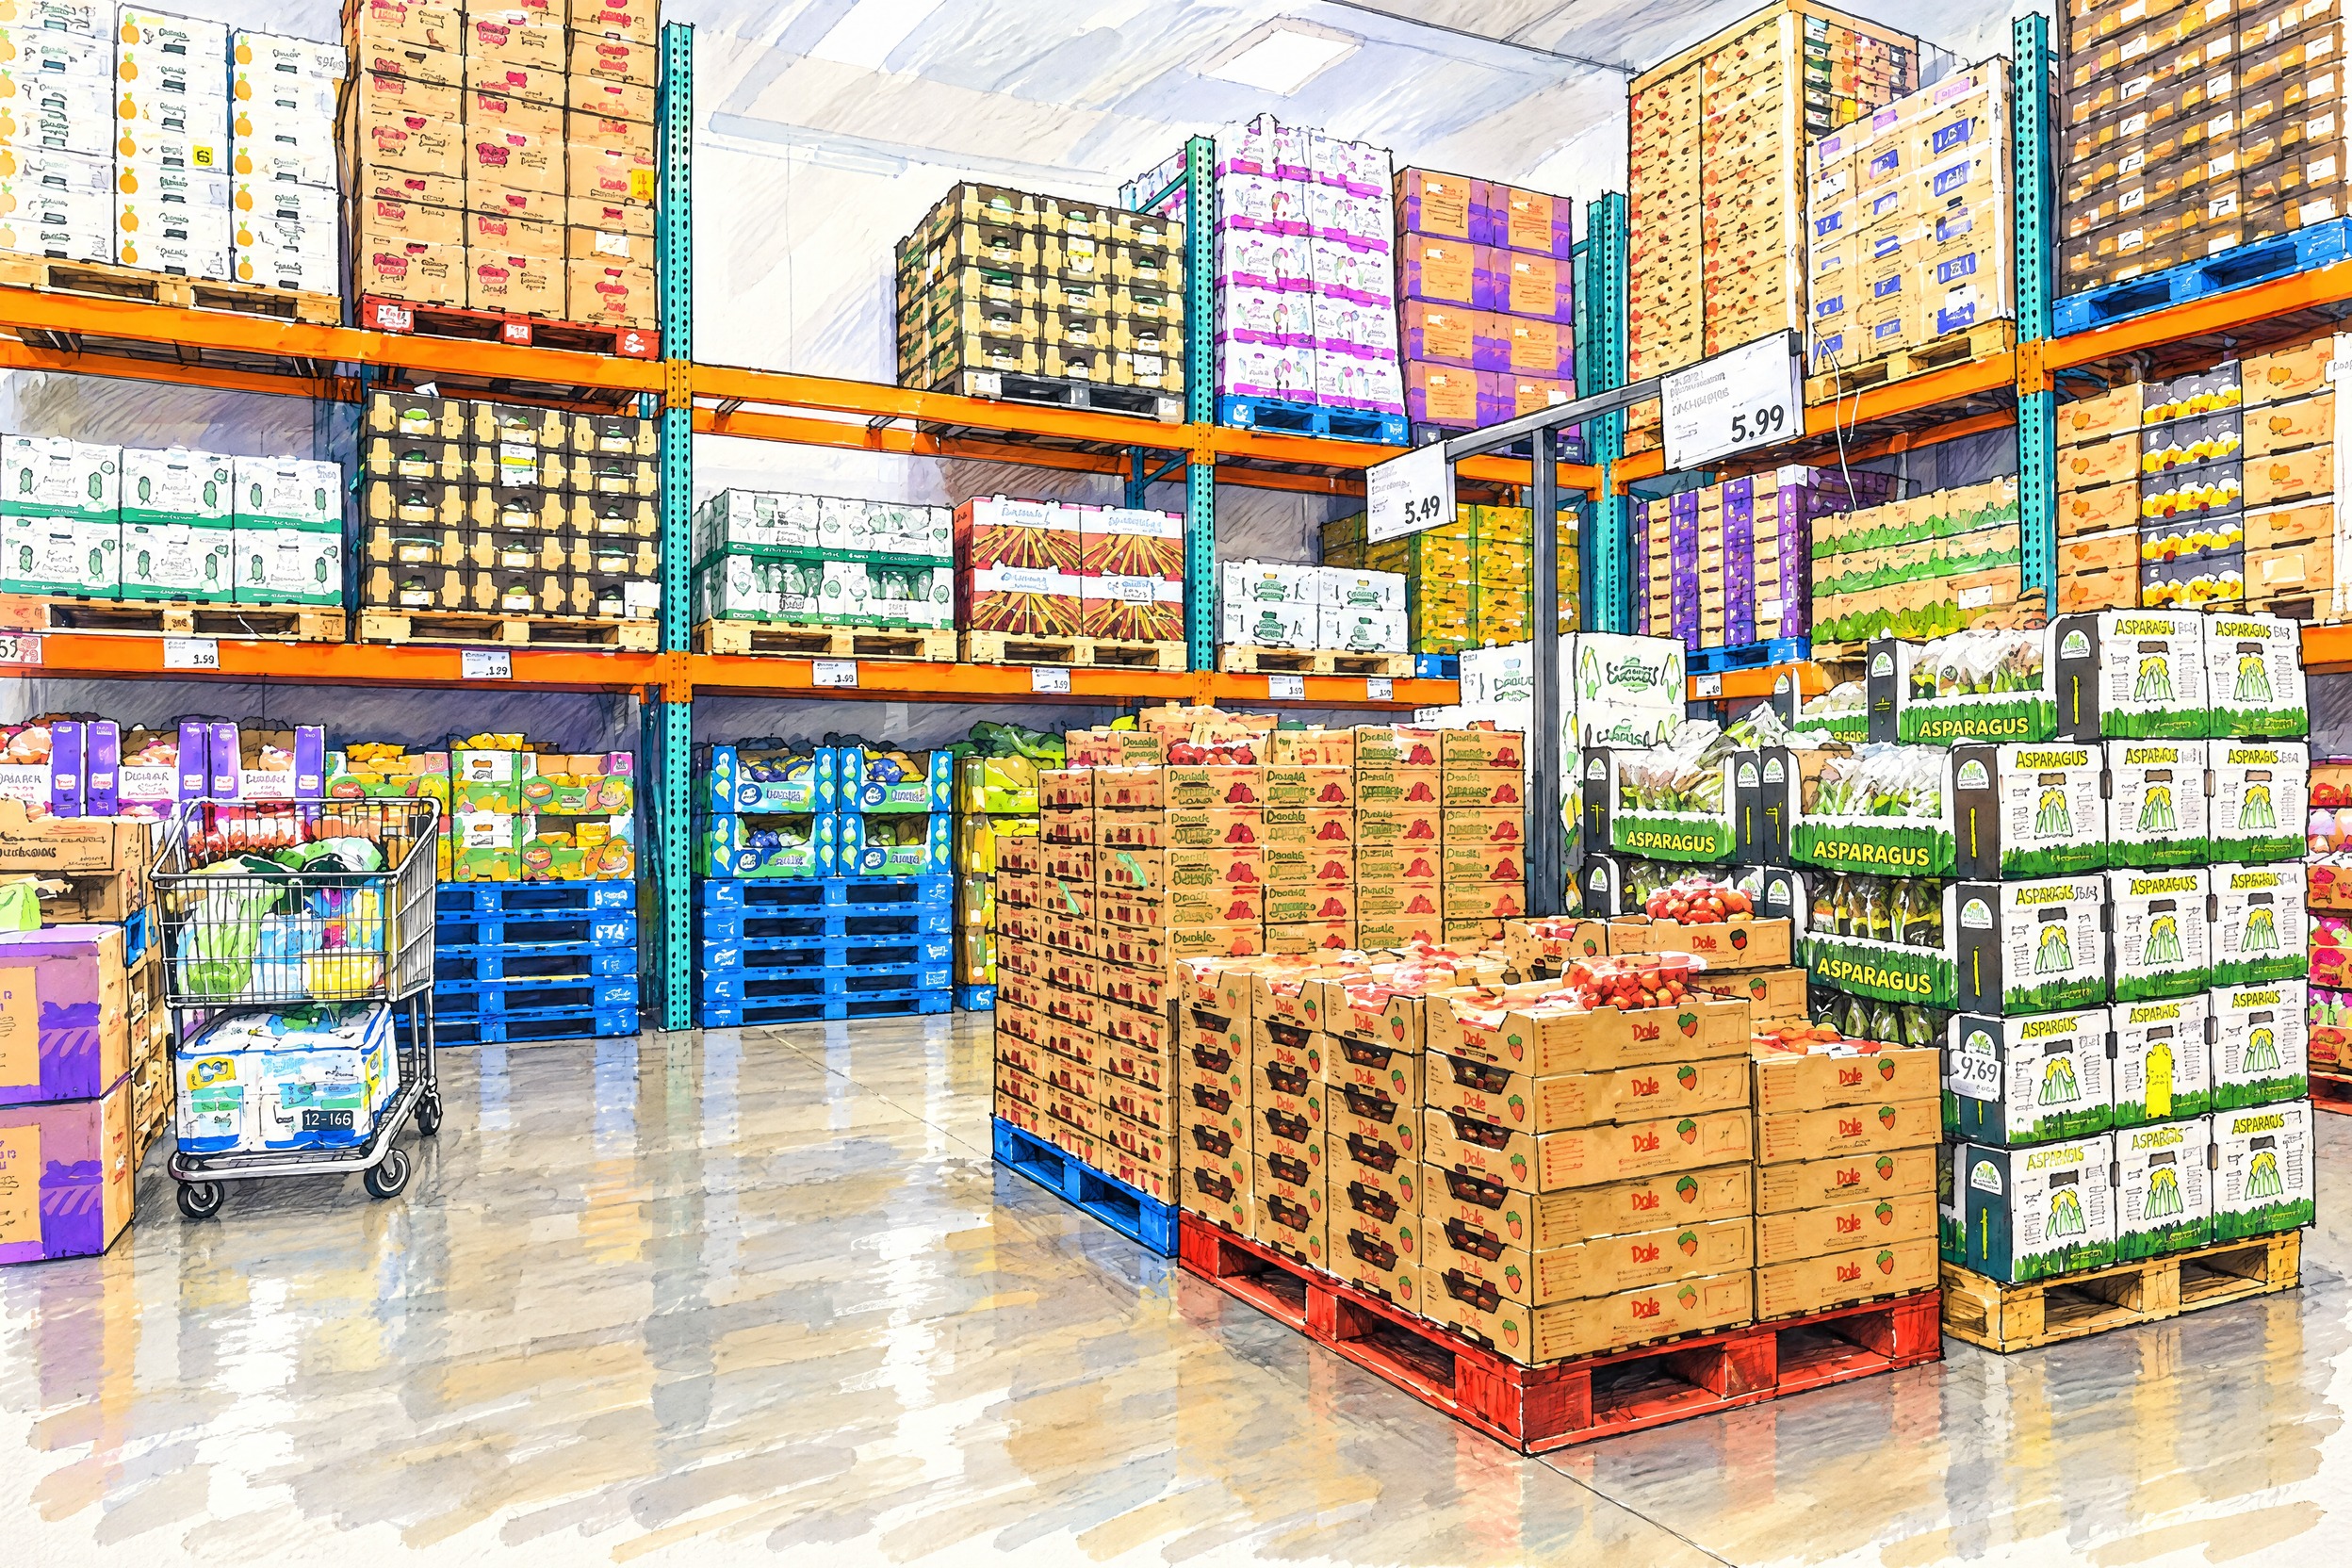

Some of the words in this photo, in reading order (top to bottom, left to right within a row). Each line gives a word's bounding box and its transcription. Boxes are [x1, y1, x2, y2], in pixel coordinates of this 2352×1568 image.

[1731, 404, 1785, 443] 5.99
[1405, 495, 1441, 525] 5.49
[1919, 717, 2029, 739] ASPARAGUS
[2016, 751, 2089, 769] ASPARAGUS
[1625, 830, 1716, 854] ASPARAGUS
[1813, 841, 1931, 867] ASPARAGUS
[2130, 876, 2197, 895] ASPARAGUS
[1543, 939, 1561, 956] Dole
[1691, 935, 1717, 950] Dole
[1816, 956, 1933, 994] ASPARAGUS
[1198, 988, 1216, 1001] Dole
[1275, 999, 1295, 1014] Dole
[1353, 1013, 1374, 1031] Dole
[1631, 1021, 1660, 1040] Dole
[1200, 1032, 1217, 1046] Dole
[1463, 1030, 1486, 1046] Dole
[1276, 1048, 1296, 1066] Dole
[1200, 1071, 1218, 1086] Dole
[1354, 1068, 1376, 1086] Dole
[1838, 1067, 1863, 1085] Dole
[1961, 1055, 1998, 1083] 9.69
[1631, 1076, 1660, 1096] Dole
[1276, 1095, 1295, 1113] Dole
[1463, 1091, 1486, 1111] Dole
[304, 1113, 352, 1126] 12-166
[1201, 1112, 1218, 1127] Dole
[1358, 1119, 1379, 1138] Dole
[1838, 1118, 1863, 1135] Dole
[1277, 1139, 1295, 1156] Dole
[1631, 1131, 1660, 1152] Dole
[1202, 1155, 1219, 1171] Dole
[1463, 1149, 1486, 1168] Dole
[1359, 1168, 1380, 1187] Dole
[1837, 1168, 1861, 1185] Dole
[1278, 1183, 1296, 1200] Dole
[1631, 1190, 1660, 1210] Dole
[1461, 1205, 1484, 1226] Dole
[1836, 1213, 1862, 1233] Dole
[1279, 1227, 1296, 1245] Dole
[1360, 1217, 1380, 1237] Dole
[1631, 1242, 1660, 1263] Dole
[1360, 1264, 1380, 1284] Dole
[1461, 1255, 1483, 1277] Dole
[1837, 1262, 1862, 1282] Dole
[1631, 1297, 1660, 1317] Dole
[1460, 1307, 1482, 1331] Dole
